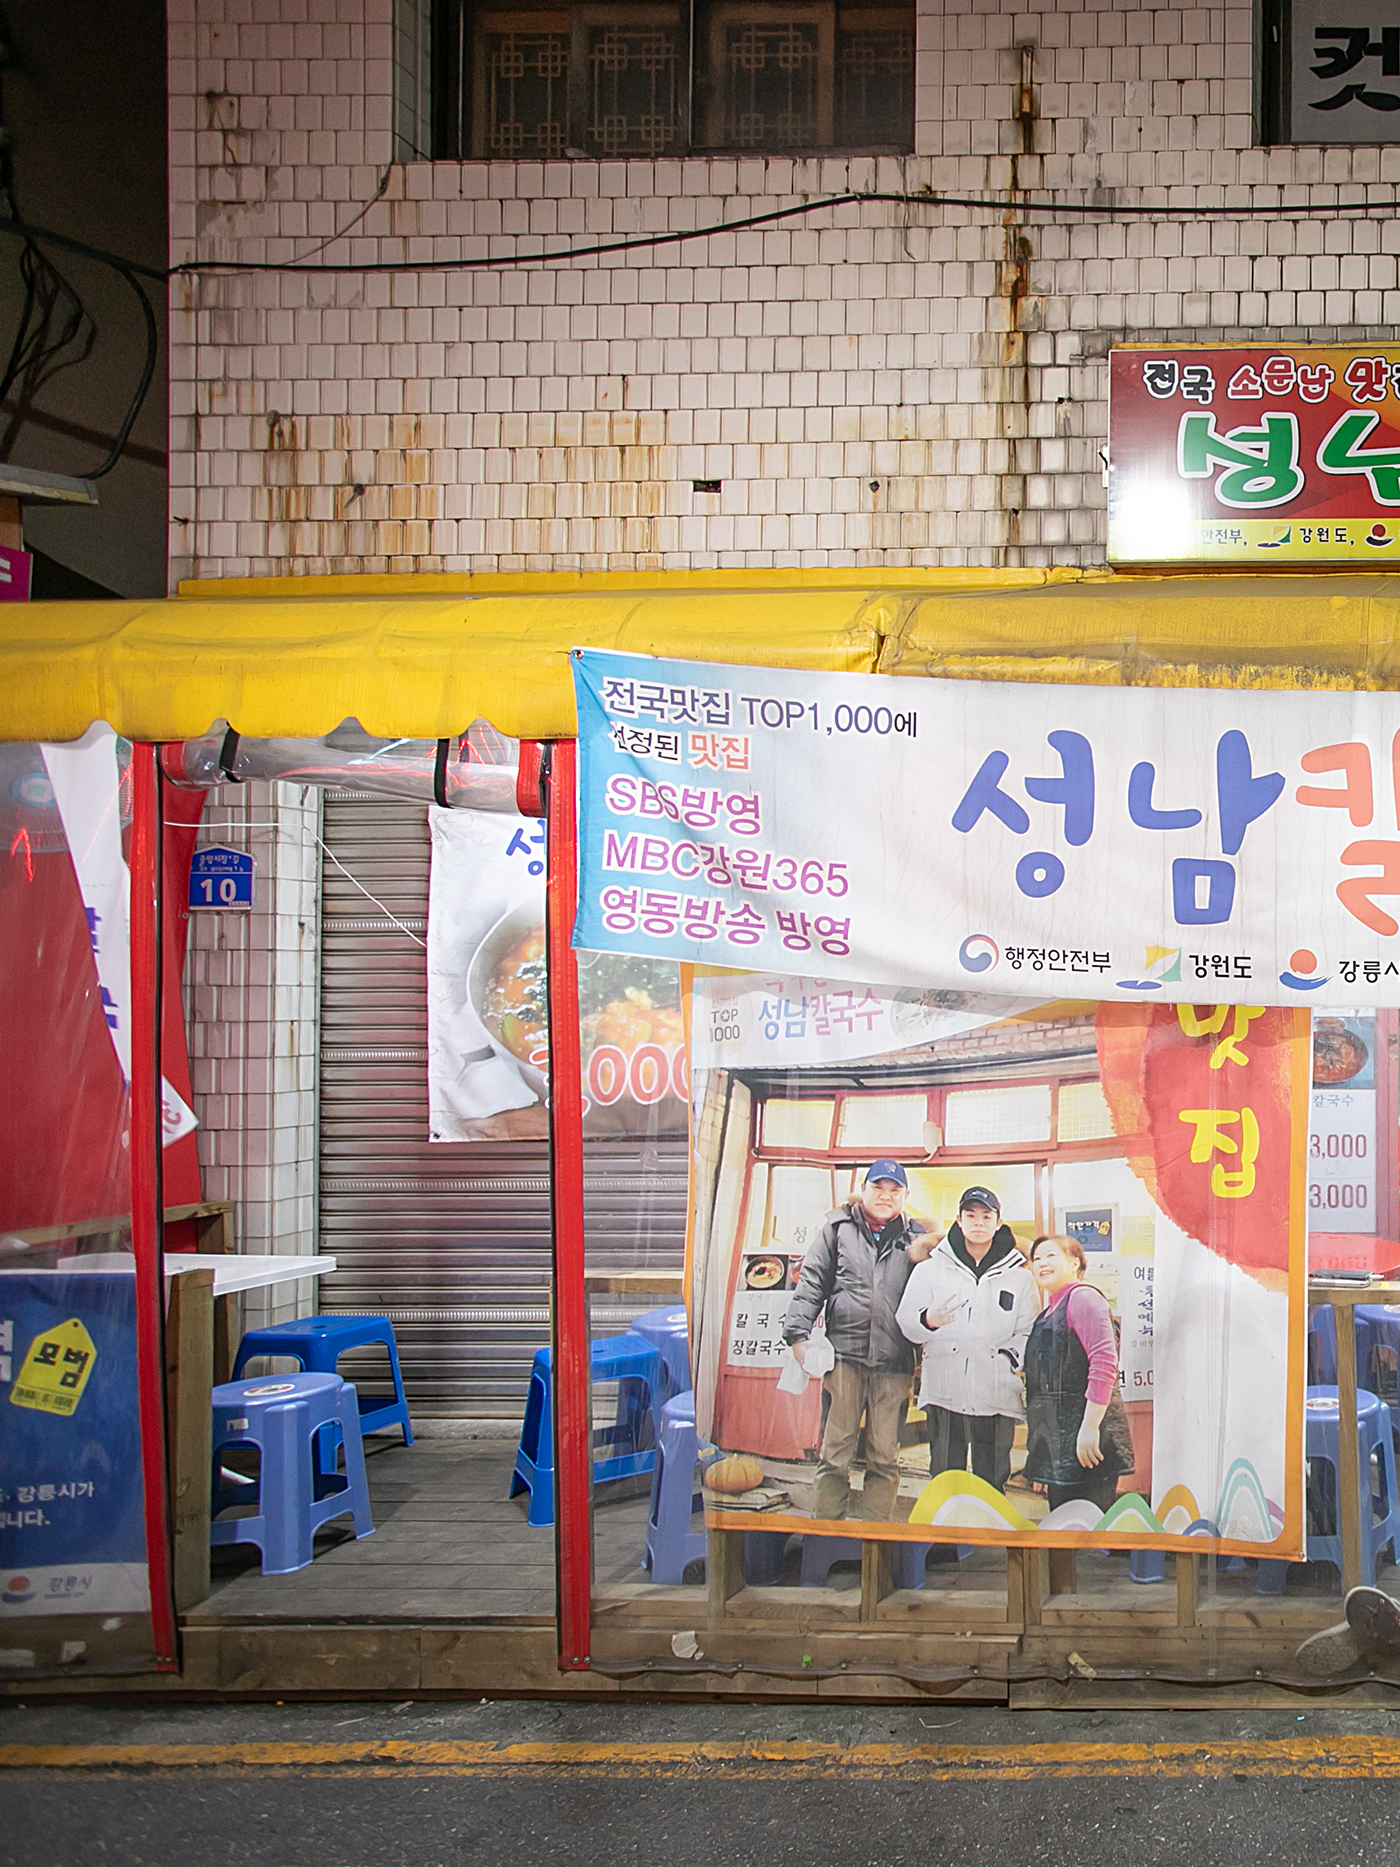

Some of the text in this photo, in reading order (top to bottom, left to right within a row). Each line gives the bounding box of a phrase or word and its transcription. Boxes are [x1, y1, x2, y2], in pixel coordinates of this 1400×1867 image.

[1143, 359, 1215, 405] 전국
[1228, 356, 1334, 403] 소문난
[603, 679, 919, 738] 전국맛집 TOP1,000에
[691, 733, 751, 771] 맛집
[608, 776, 763, 836] SBS방영
[605, 833, 850, 898] MBC강원365
[200, 878, 237, 903] 10
[603, 888, 852, 957] 영동방송 방영
[1004, 944, 1112, 971] 행정안전부
[1188, 952, 1253, 980] 강원도
[710, 1008, 739, 1025] TOP
[710, 1024, 741, 1042] 1000
[1310, 1134, 1367, 1159] 3,000
[1309, 1184, 1367, 1209] 3,000
[732, 1339, 787, 1356] 장칼국수
[18, 1482, 95, 1503] 강릉시가
